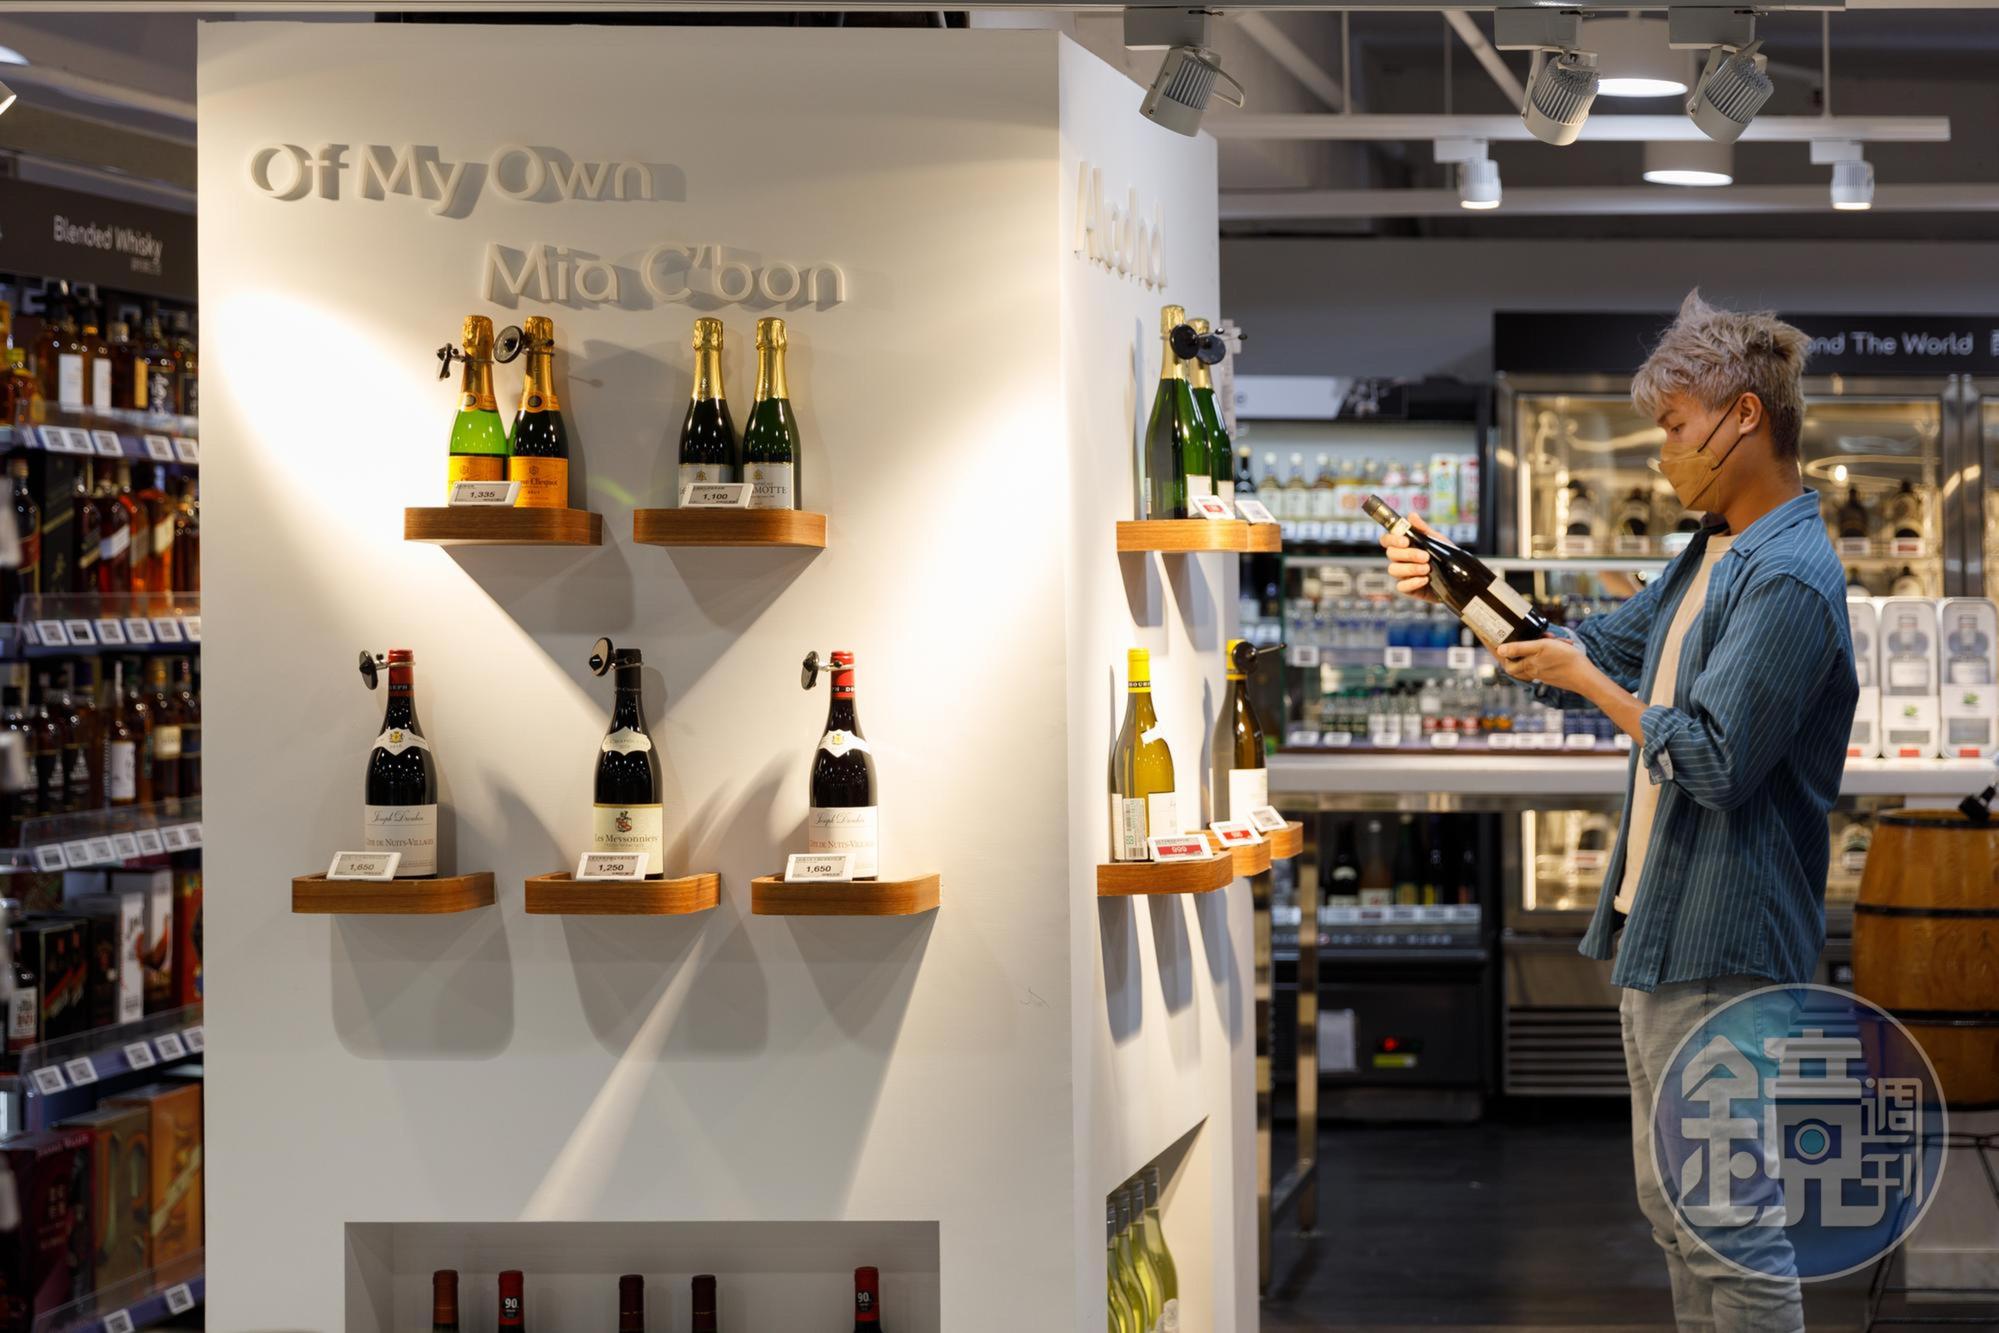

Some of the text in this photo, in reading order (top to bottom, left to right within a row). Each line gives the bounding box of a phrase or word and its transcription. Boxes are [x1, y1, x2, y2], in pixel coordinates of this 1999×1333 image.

[250, 143, 654, 217] Of My Own
[53, 214, 163, 265] Blended Whisky
[481, 242, 619, 301] Mia
[1851, 331, 1897, 355] The
[1901, 331, 1974, 356] World
[470, 490, 496, 499] 1,335
[703, 493, 728, 501] 1,100
[599, 864, 624, 872] 1,250
[806, 865, 832, 874] 1,650
[857, 1292, 870, 1303] 90
[505, 1298, 518, 1309] 90
